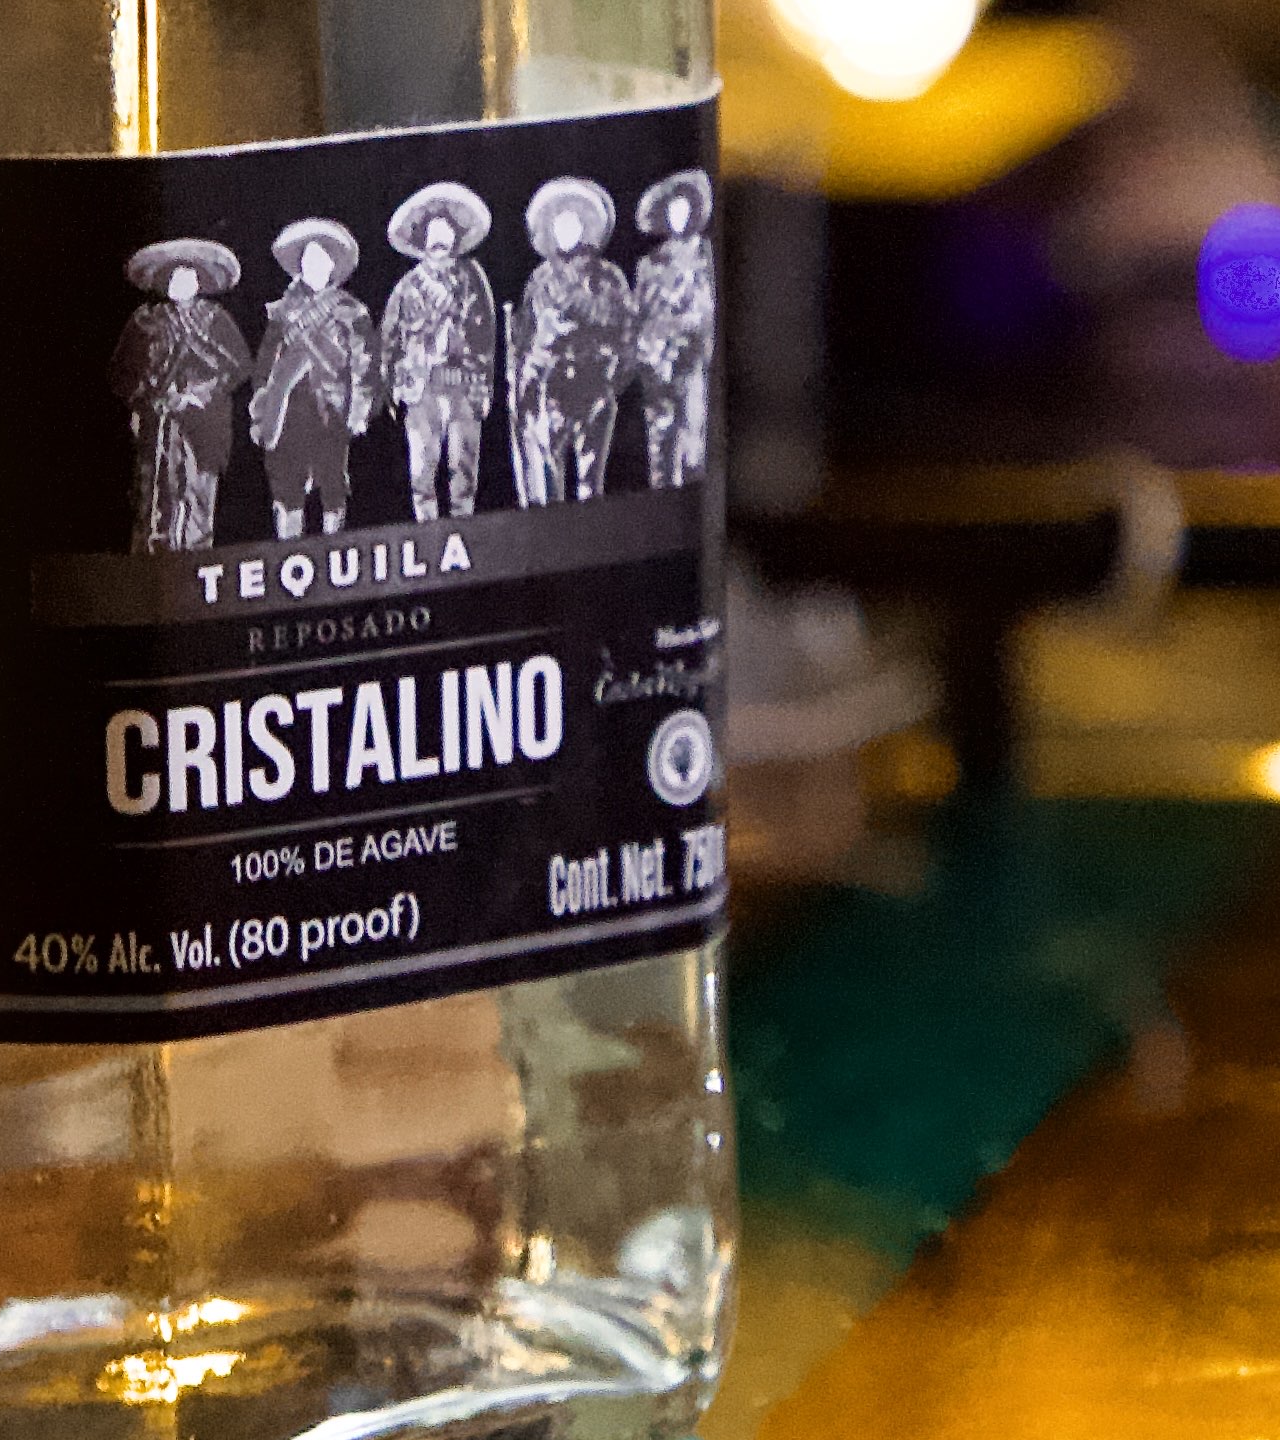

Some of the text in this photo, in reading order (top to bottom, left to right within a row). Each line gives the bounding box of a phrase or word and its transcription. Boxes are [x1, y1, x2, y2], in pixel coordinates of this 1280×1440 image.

[196, 532, 472, 604] TEQUILA
[248, 605, 431, 653] REPOSADO
[105, 653, 564, 816] CRISTALINO
[231, 820, 458, 884] 100% DE AGAVE
[549, 848, 619, 916] Cont.
[14, 891, 421, 974] 40% Alc. Vol. (80 proof)
